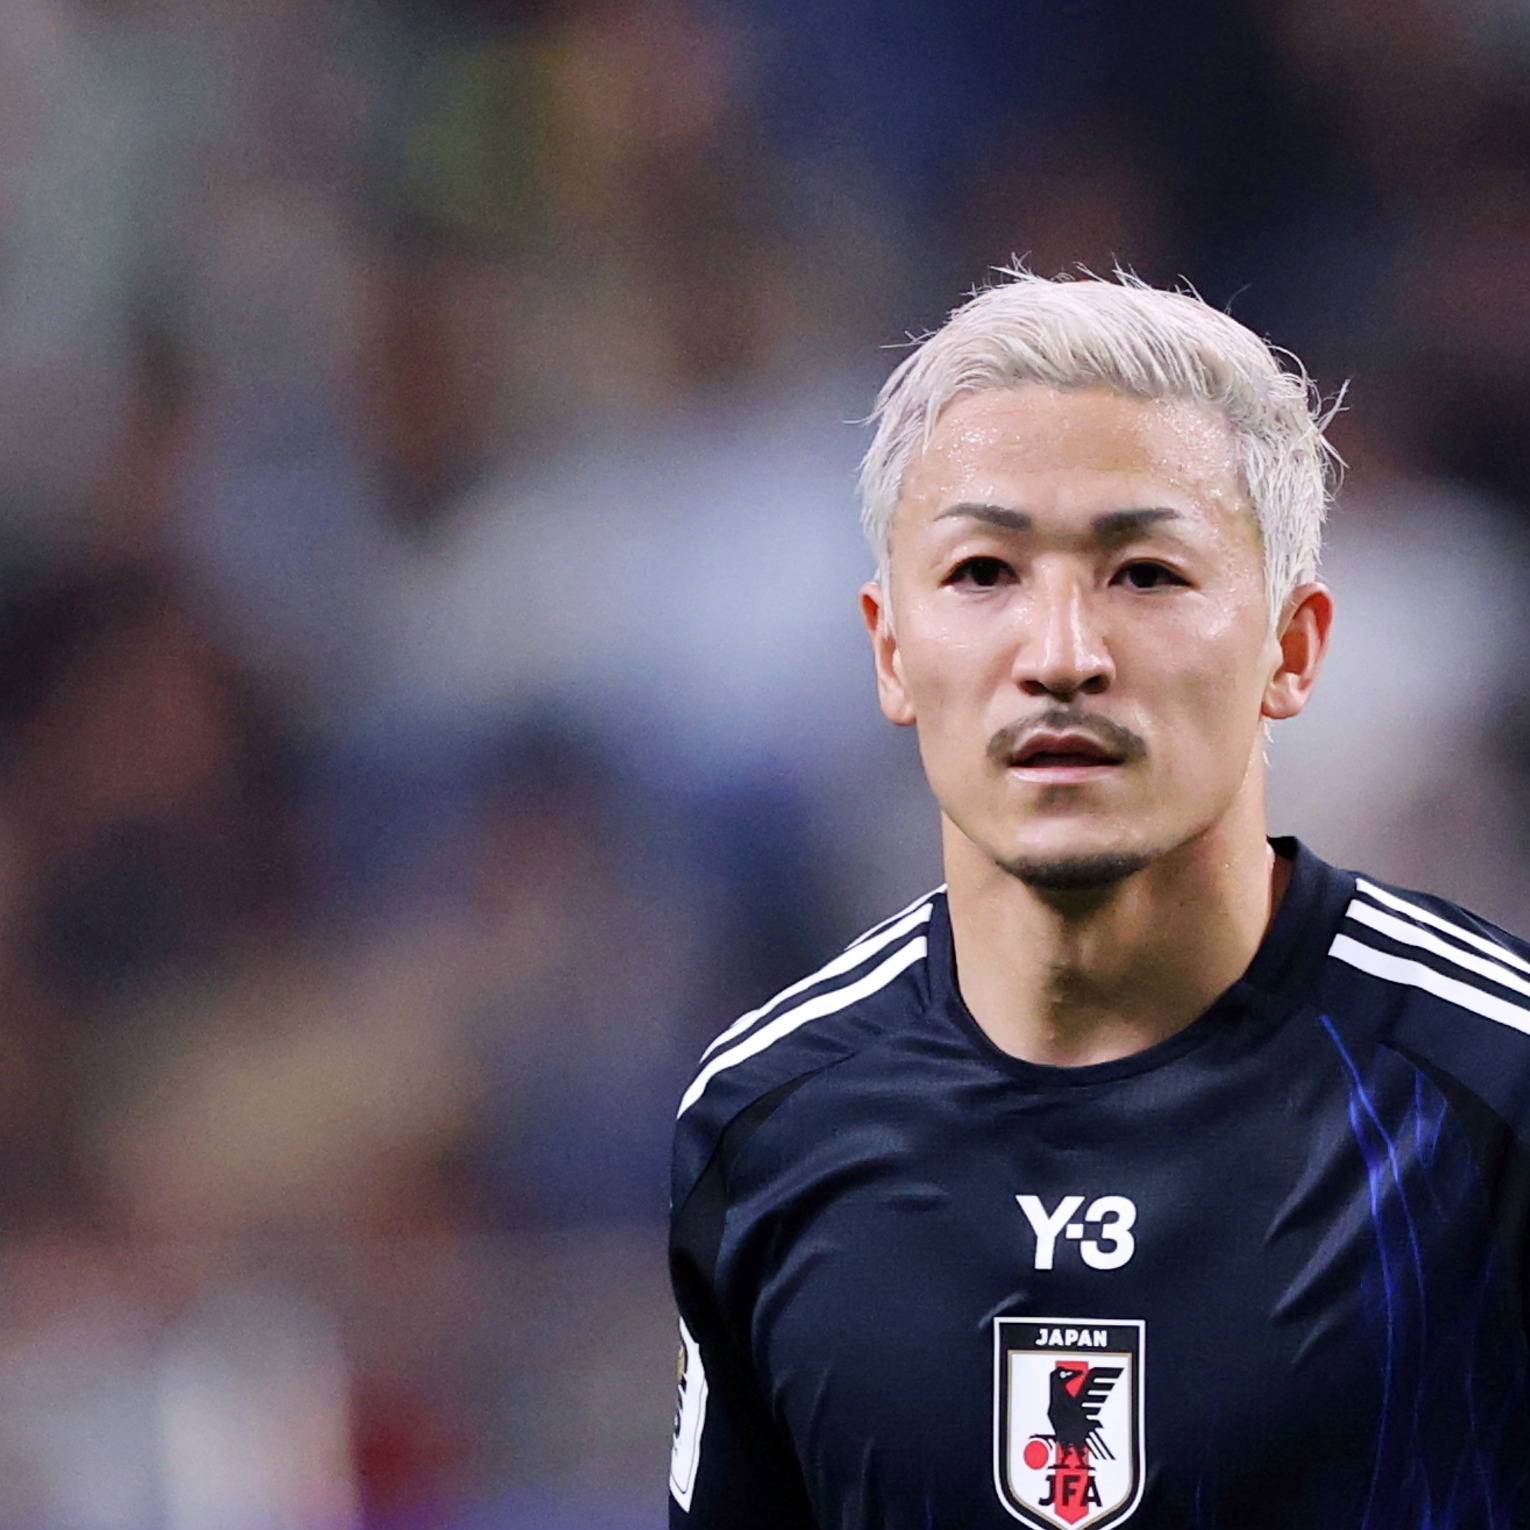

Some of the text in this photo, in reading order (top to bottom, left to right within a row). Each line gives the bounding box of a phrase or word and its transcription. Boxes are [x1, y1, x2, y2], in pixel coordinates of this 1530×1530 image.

[1015, 1194, 1137, 1270] Y-3
[1035, 1327, 1108, 1348] JAPAN
[1038, 1475, 1104, 1508] JFA
